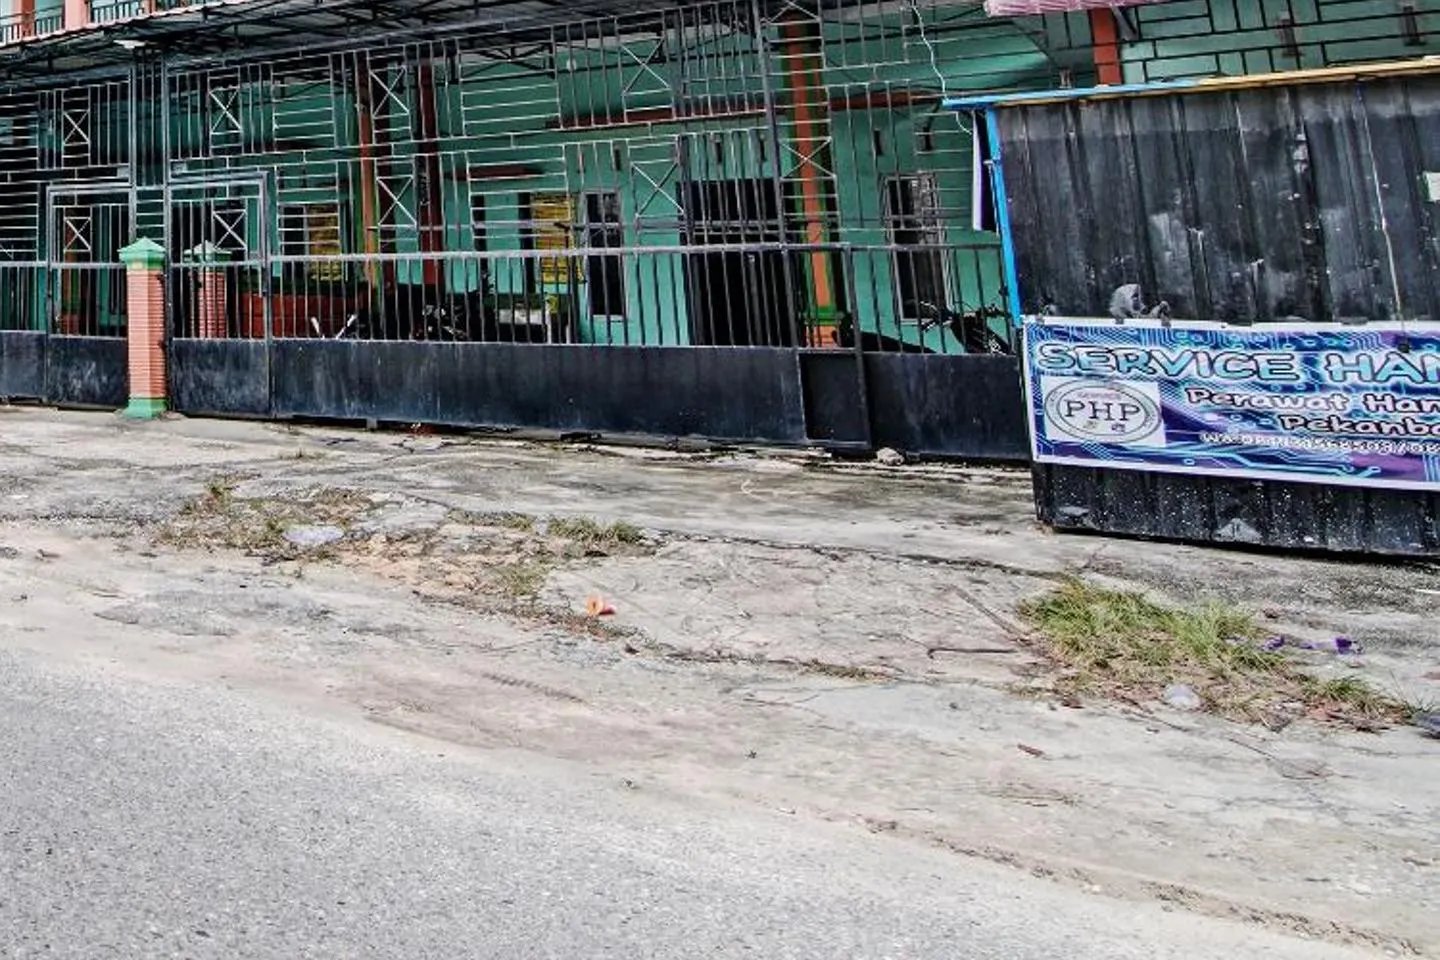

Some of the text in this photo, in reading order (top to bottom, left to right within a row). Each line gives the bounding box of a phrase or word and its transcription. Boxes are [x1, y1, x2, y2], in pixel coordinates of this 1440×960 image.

[1039, 343, 1301, 381] SERVICE
[1064, 400, 1141, 421] PHP
[1186, 387, 1350, 412] Perawat
